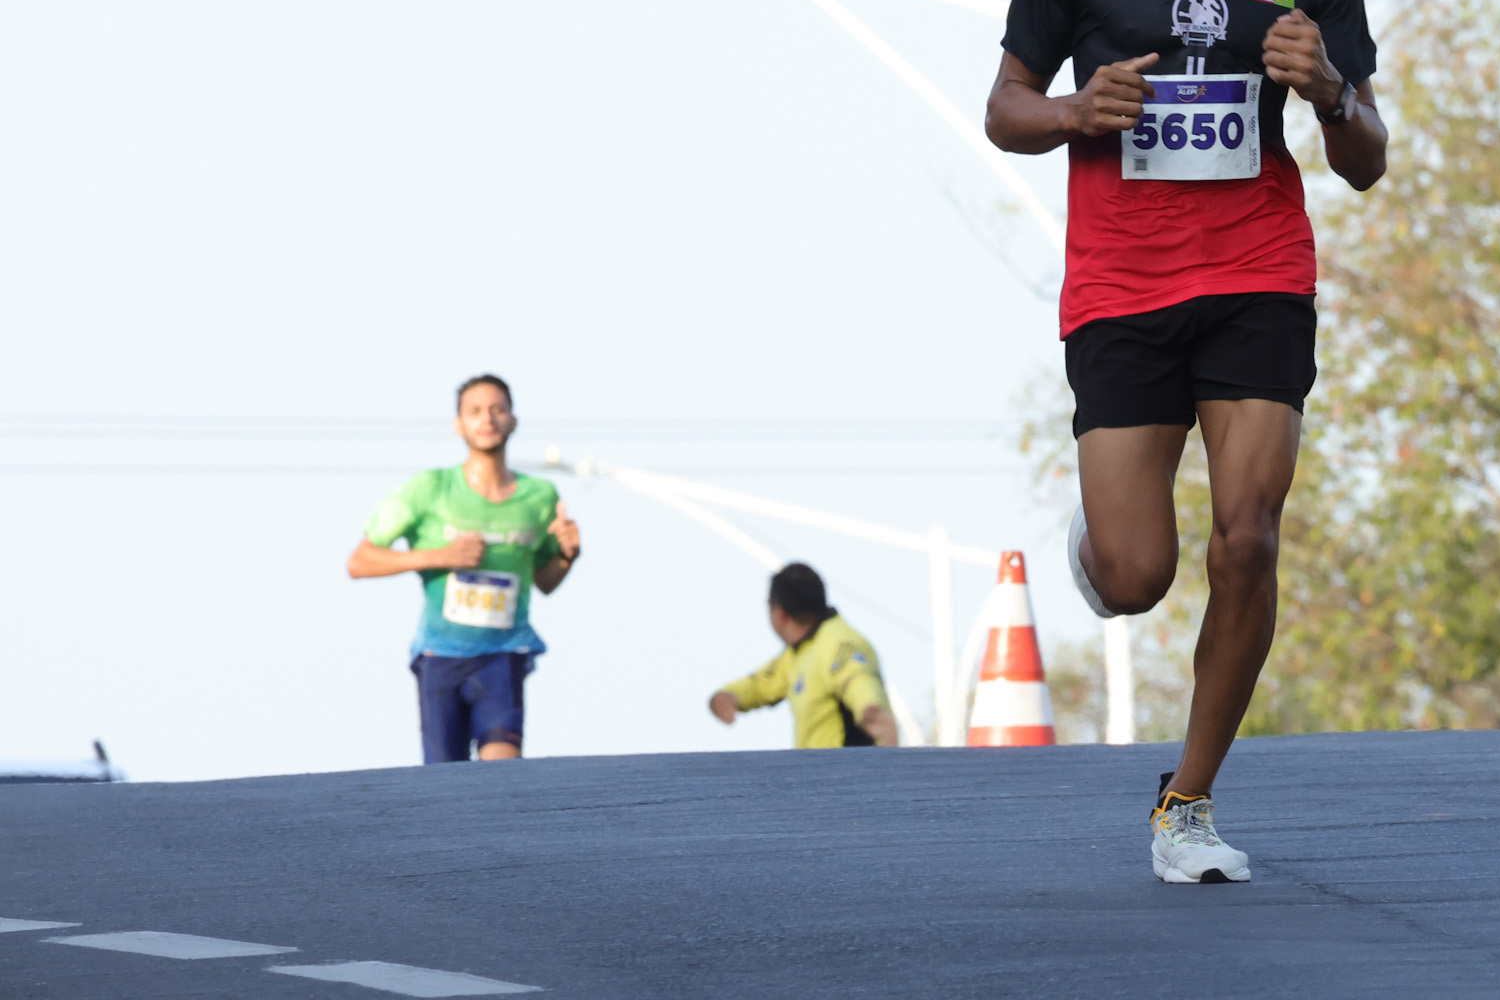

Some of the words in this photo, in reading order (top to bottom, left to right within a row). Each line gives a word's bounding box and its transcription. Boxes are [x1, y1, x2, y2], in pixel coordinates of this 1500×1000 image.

[1179, 23, 1191, 31] THE
[1192, 25, 1221, 33] RUNNERS
[1132, 112, 1244, 150] 5650
